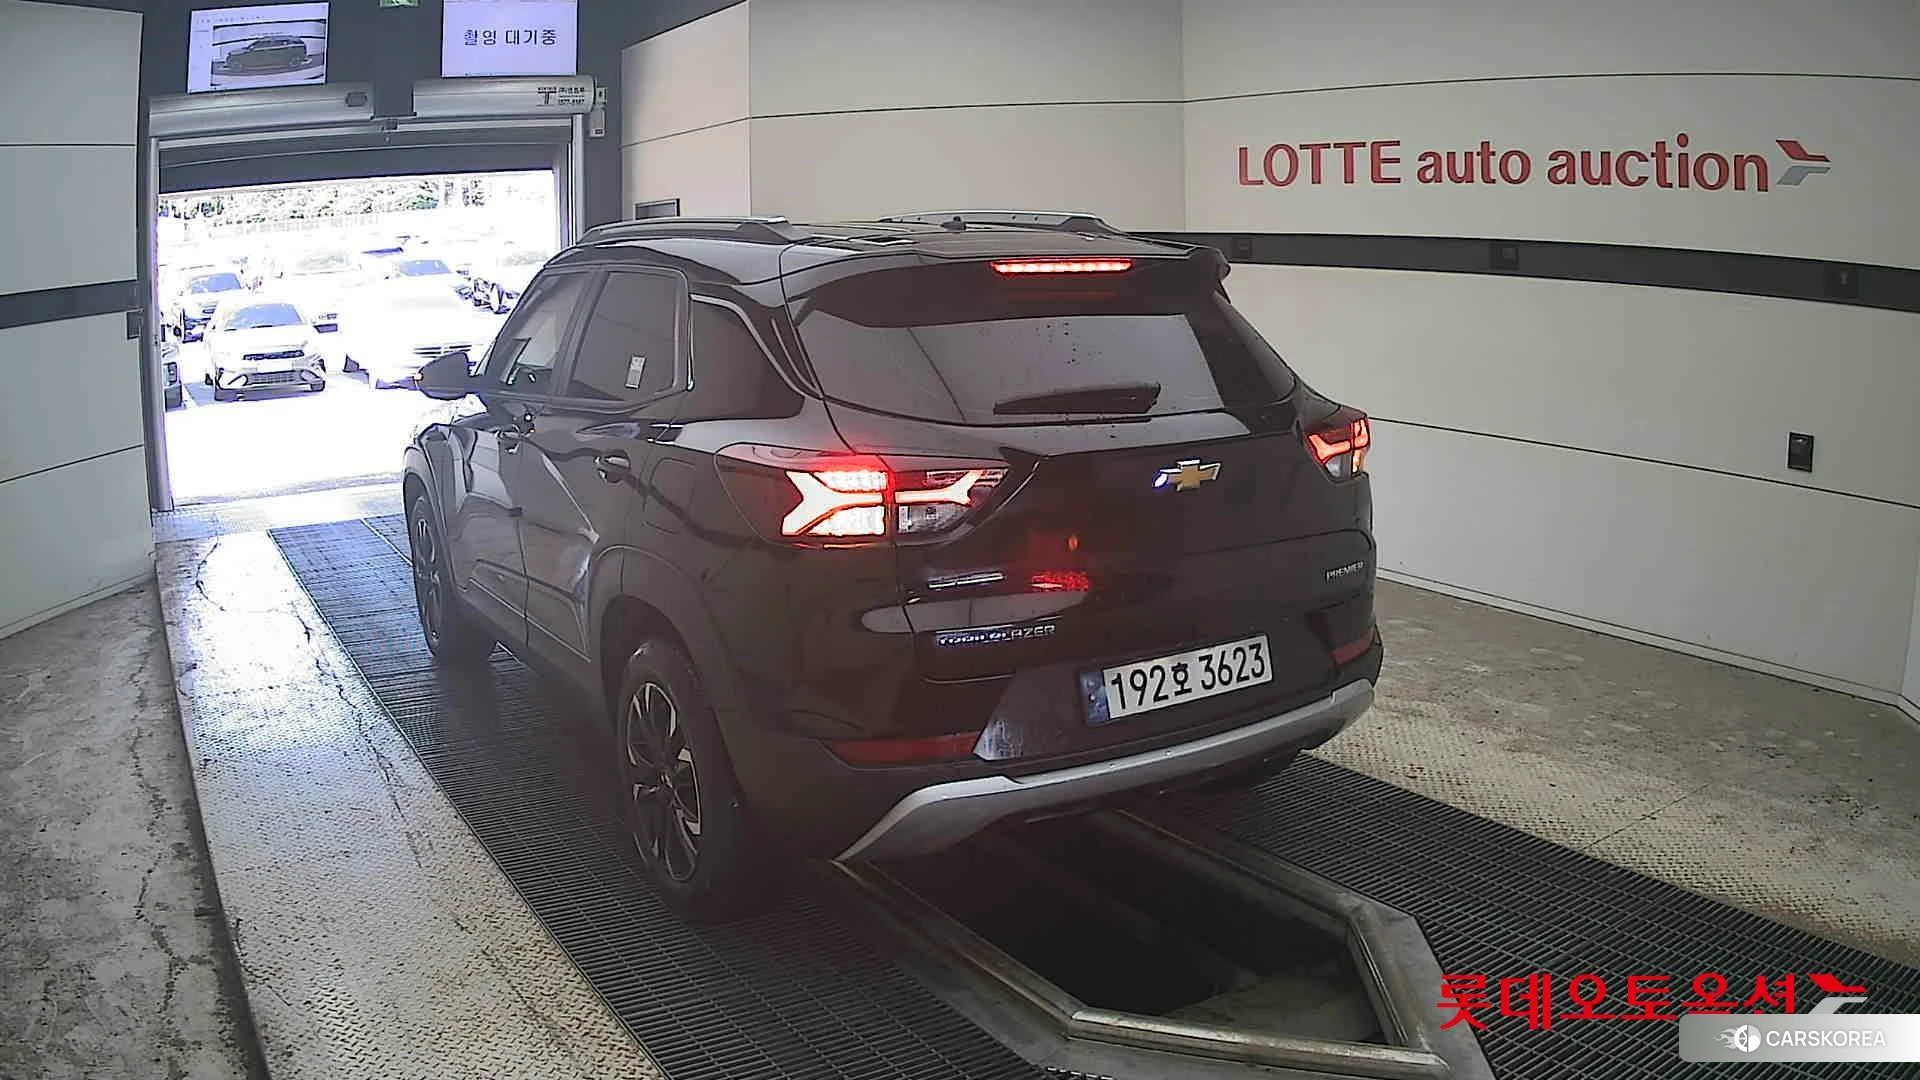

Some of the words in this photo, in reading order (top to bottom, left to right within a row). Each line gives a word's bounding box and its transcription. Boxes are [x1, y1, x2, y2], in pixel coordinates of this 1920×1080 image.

[505, 29, 557, 46] 대기중
[1239, 140, 1401, 187] LOTTE
[1416, 140, 1531, 186] auto
[1547, 133, 1769, 193] auction
[1326, 561, 1364, 582] PREMIER
[1111, 662, 1192, 710] 192호
[1198, 643, 1265, 690] 3623
